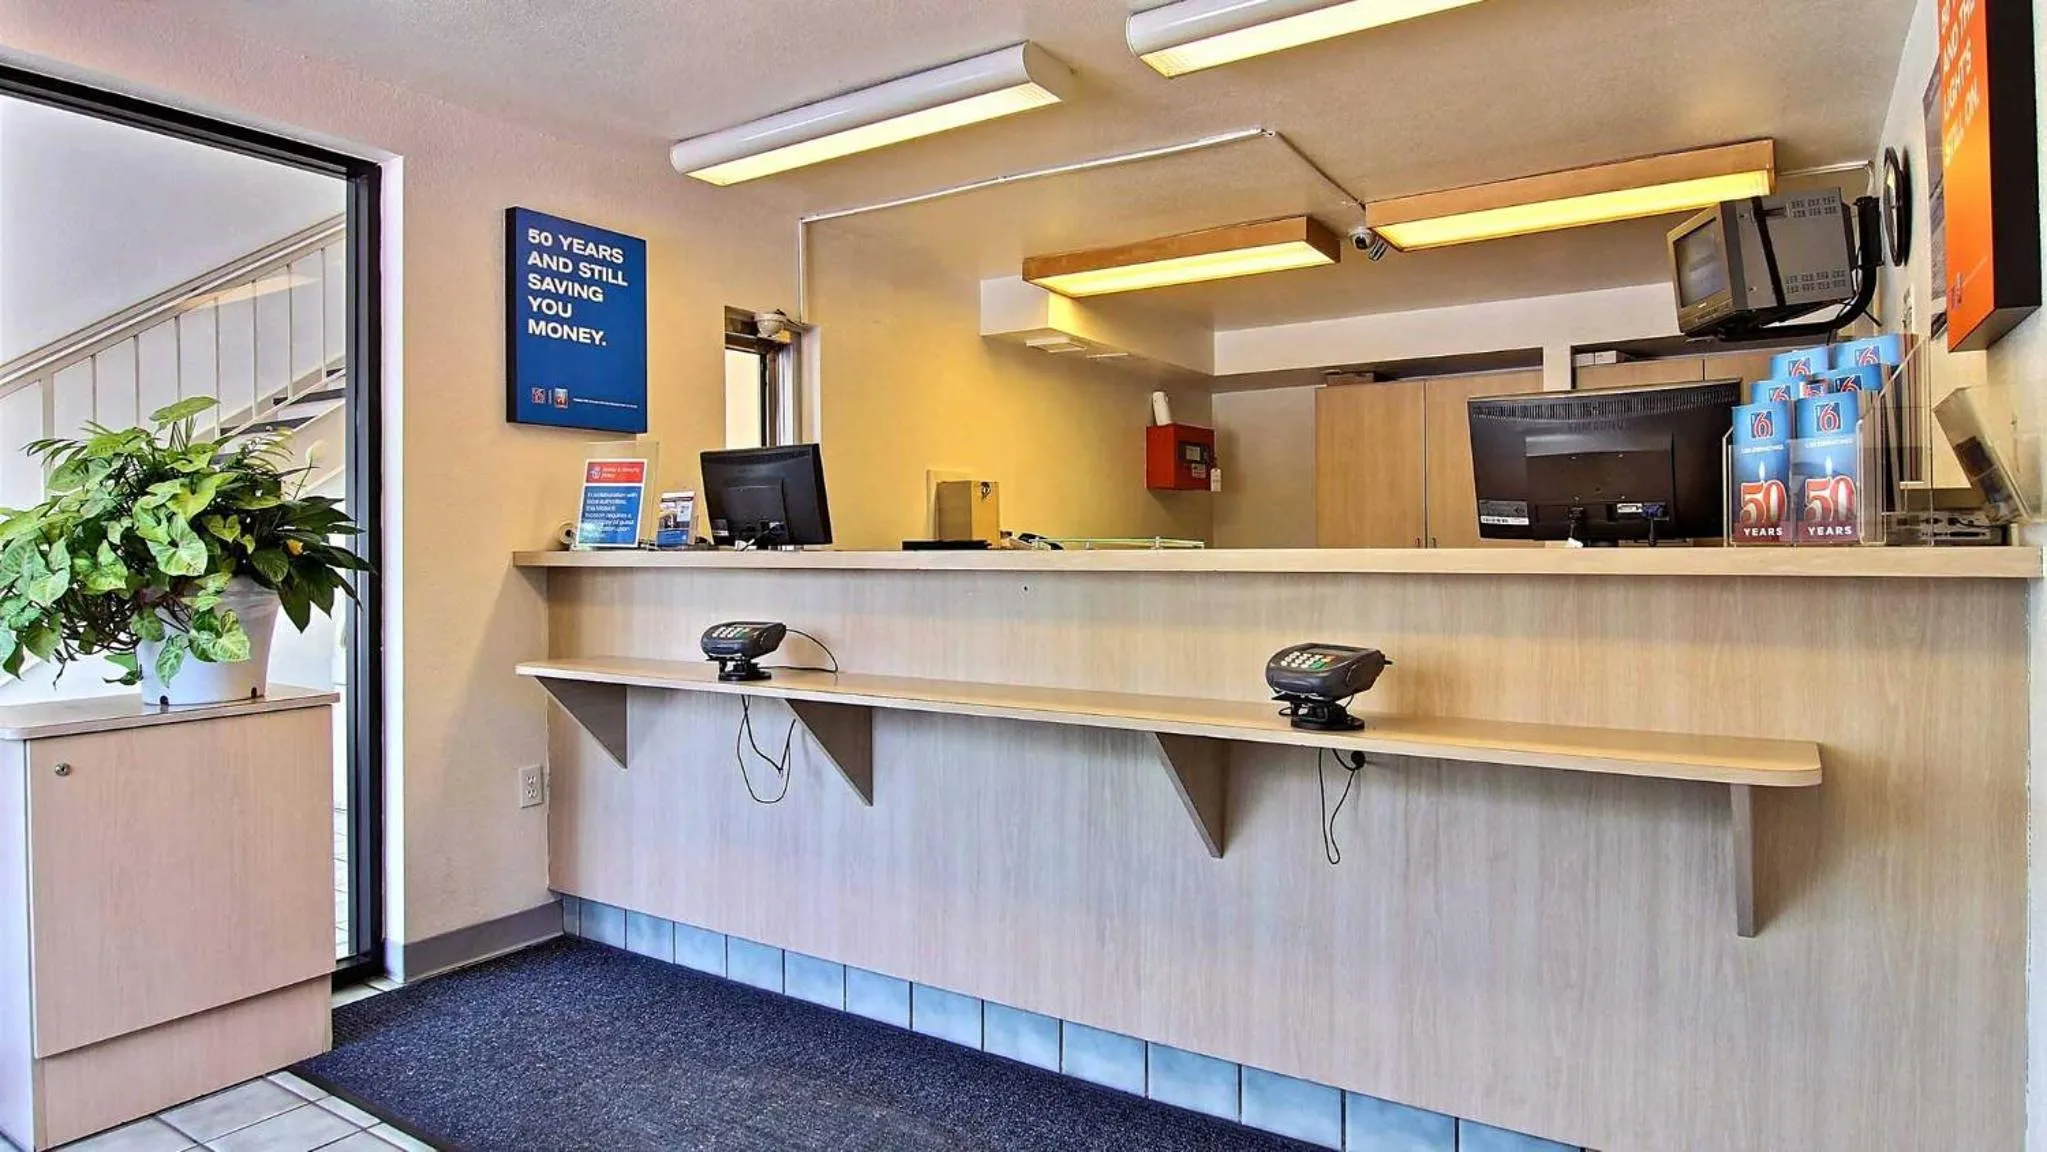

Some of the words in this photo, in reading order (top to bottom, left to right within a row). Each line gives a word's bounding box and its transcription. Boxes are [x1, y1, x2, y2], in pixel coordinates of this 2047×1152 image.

[528, 228, 553, 247] 50
[558, 234, 624, 264] YEARS
[528, 251, 573, 273] AND
[578, 263, 628, 287] STILL
[528, 273, 604, 302] SAVING
[528, 296, 572, 318] YOU
[528, 319, 607, 346] MONEY.
[1740, 479, 1788, 524] 50
[1803, 475, 1857, 523] 50
[1743, 526, 1783, 537] YEARS
[1808, 525, 1852, 536] YEARS
